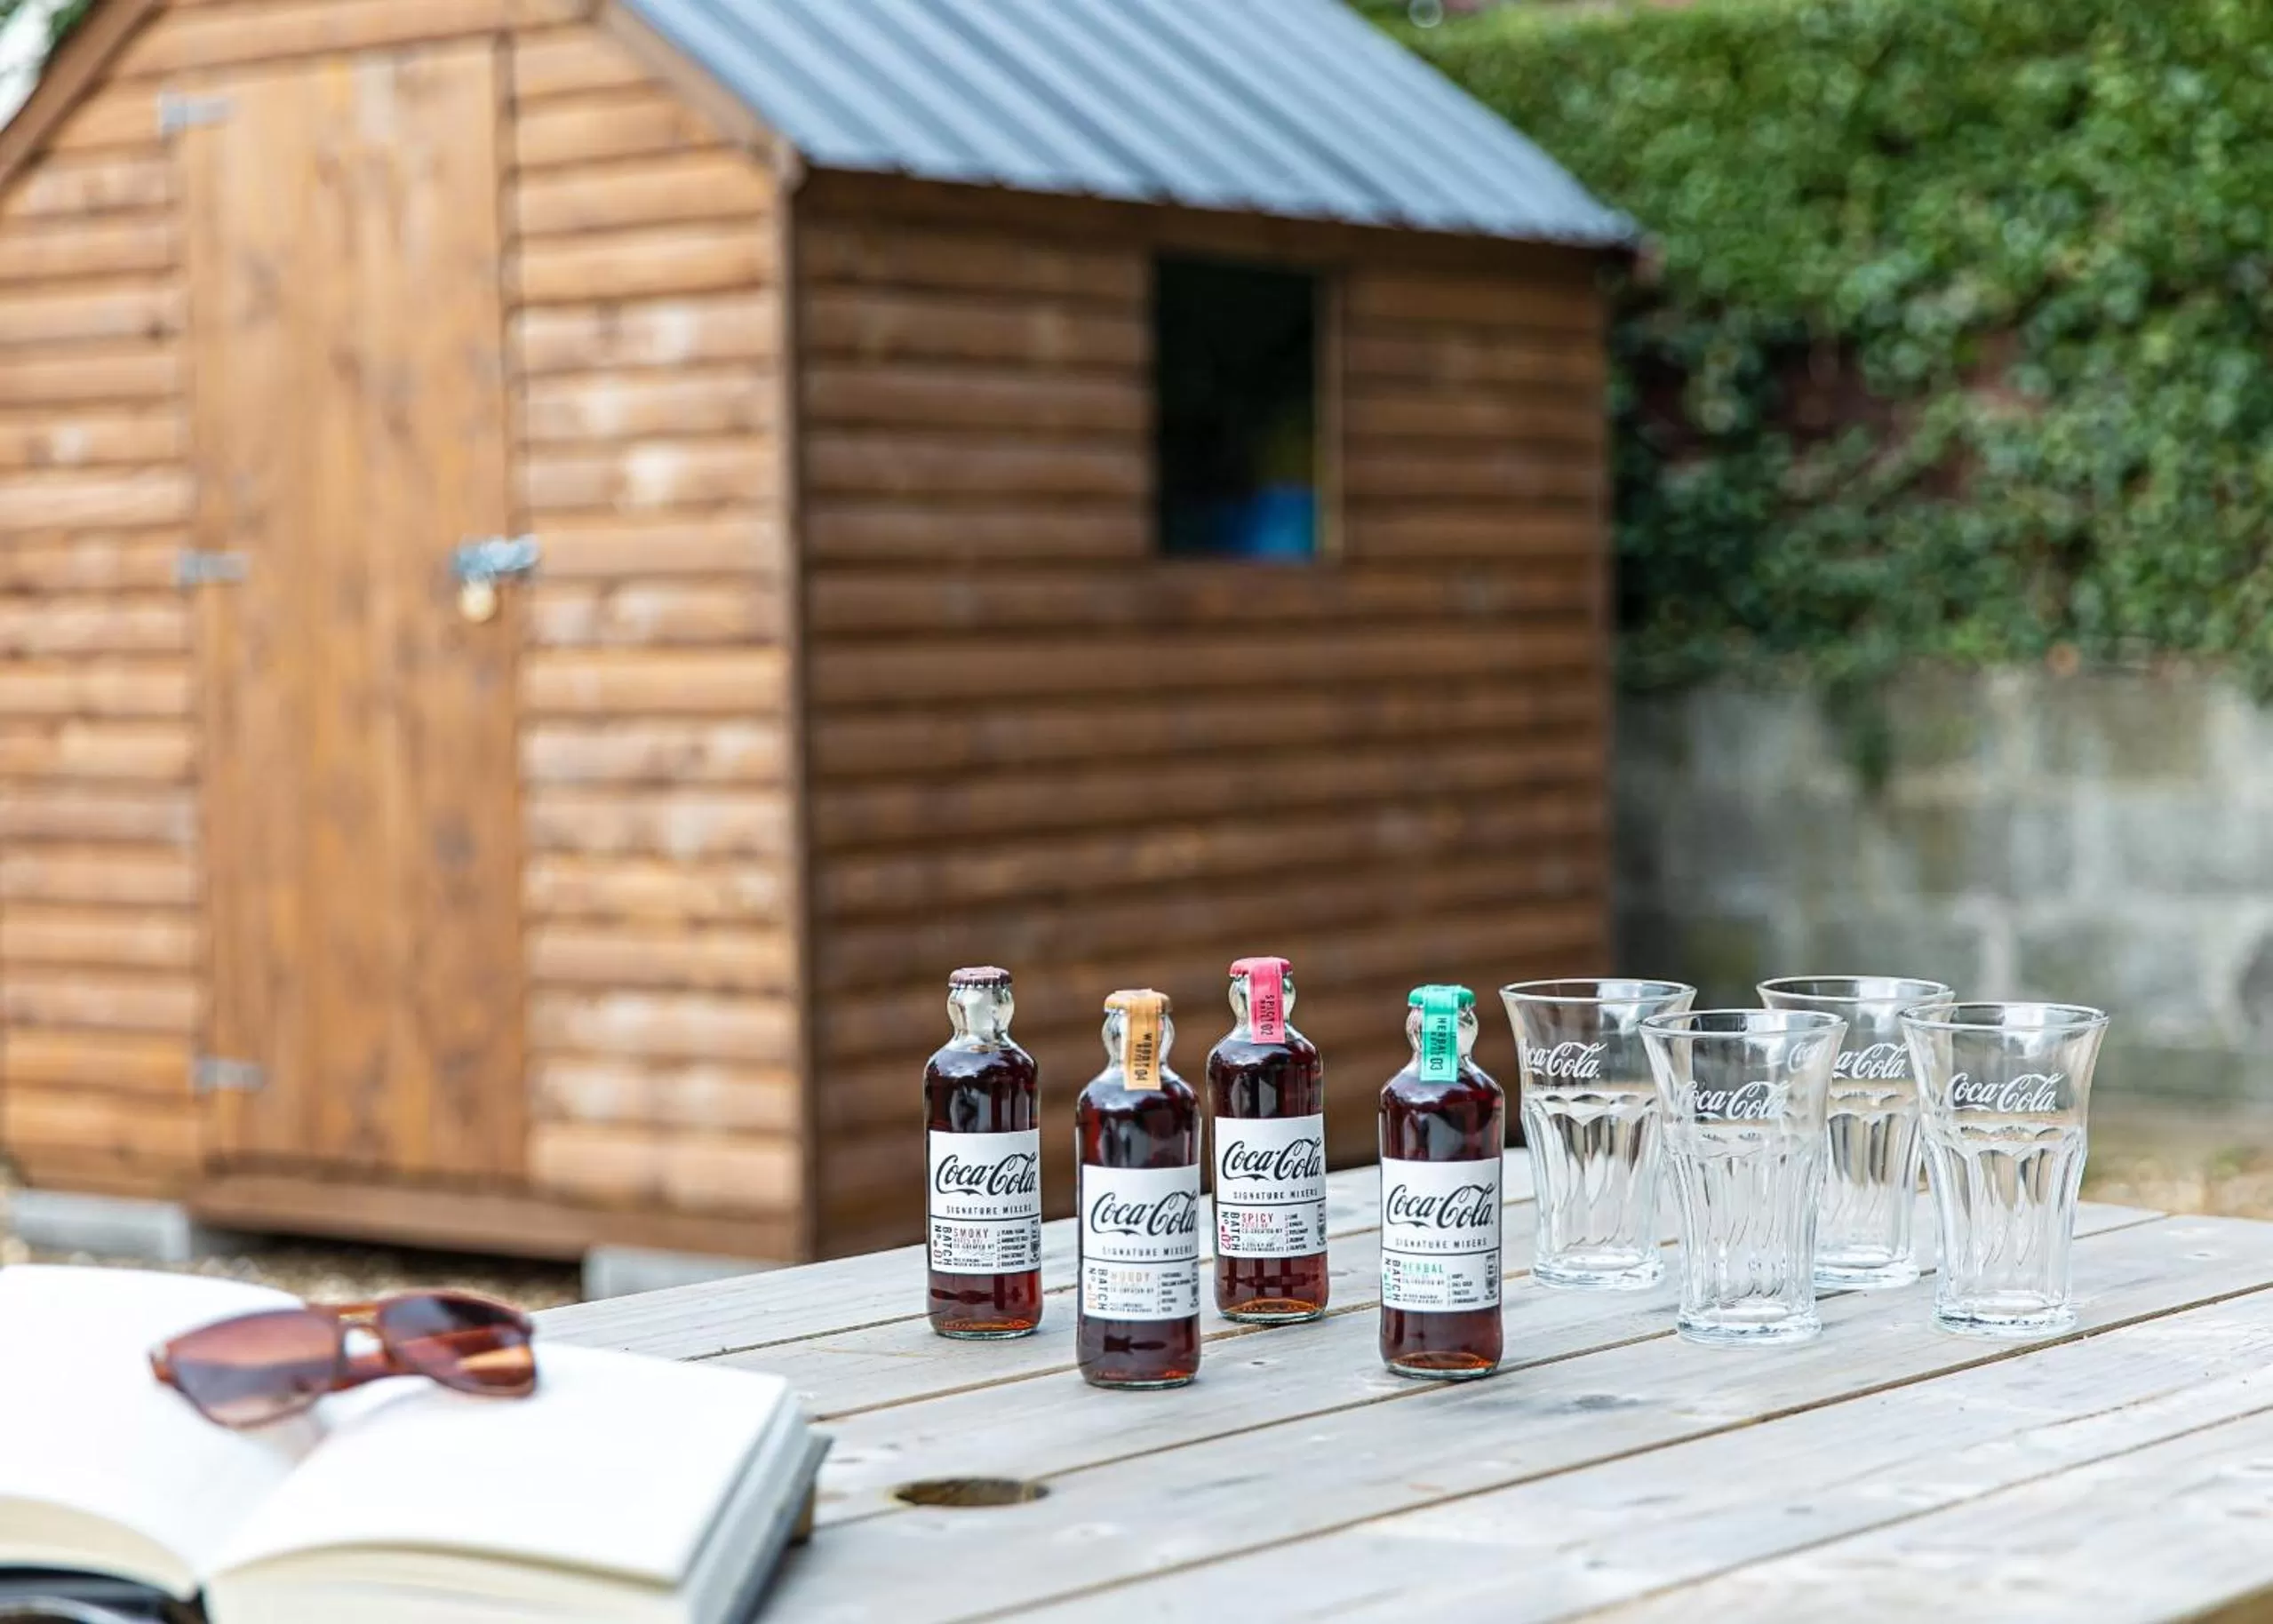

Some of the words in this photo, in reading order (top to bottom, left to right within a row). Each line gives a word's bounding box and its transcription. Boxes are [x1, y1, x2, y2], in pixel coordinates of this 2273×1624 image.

[1437, 1018, 1448, 1055] HERBAL
[1430, 1058, 1444, 1070] 03
[1944, 1072, 2067, 1111] Coca-Cola
[936, 1151, 1038, 1196] Coca-Cola
[1223, 1136, 1322, 1182] Coca-Cola
[946, 1205, 998, 1215] SIGNATURE
[1002, 1204, 1032, 1214] MIXERS
[1091, 1189, 1198, 1237] Coca-Cola
[1233, 1190, 1284, 1200] SIGNATURE
[1290, 1188, 1318, 1198] MIXERS
[1386, 1182, 1496, 1229] Coca-Cola
[953, 1227, 989, 1238] SMOKY
[1231, 1212, 1240, 1251] BATCH
[1241, 1212, 1273, 1222] SPICY
[942, 1226, 953, 1266] BATCH
[1102, 1246, 1157, 1256] SIGNATURE
[1163, 1245, 1192, 1255] MIXERS
[1396, 1238, 1448, 1248] SIGNATURE
[1454, 1238, 1487, 1248] MIXERS
[1392, 1259, 1401, 1302] BATCH
[1402, 1262, 1443, 1273] HERBAL
[1098, 1268, 1108, 1310] BATCH
